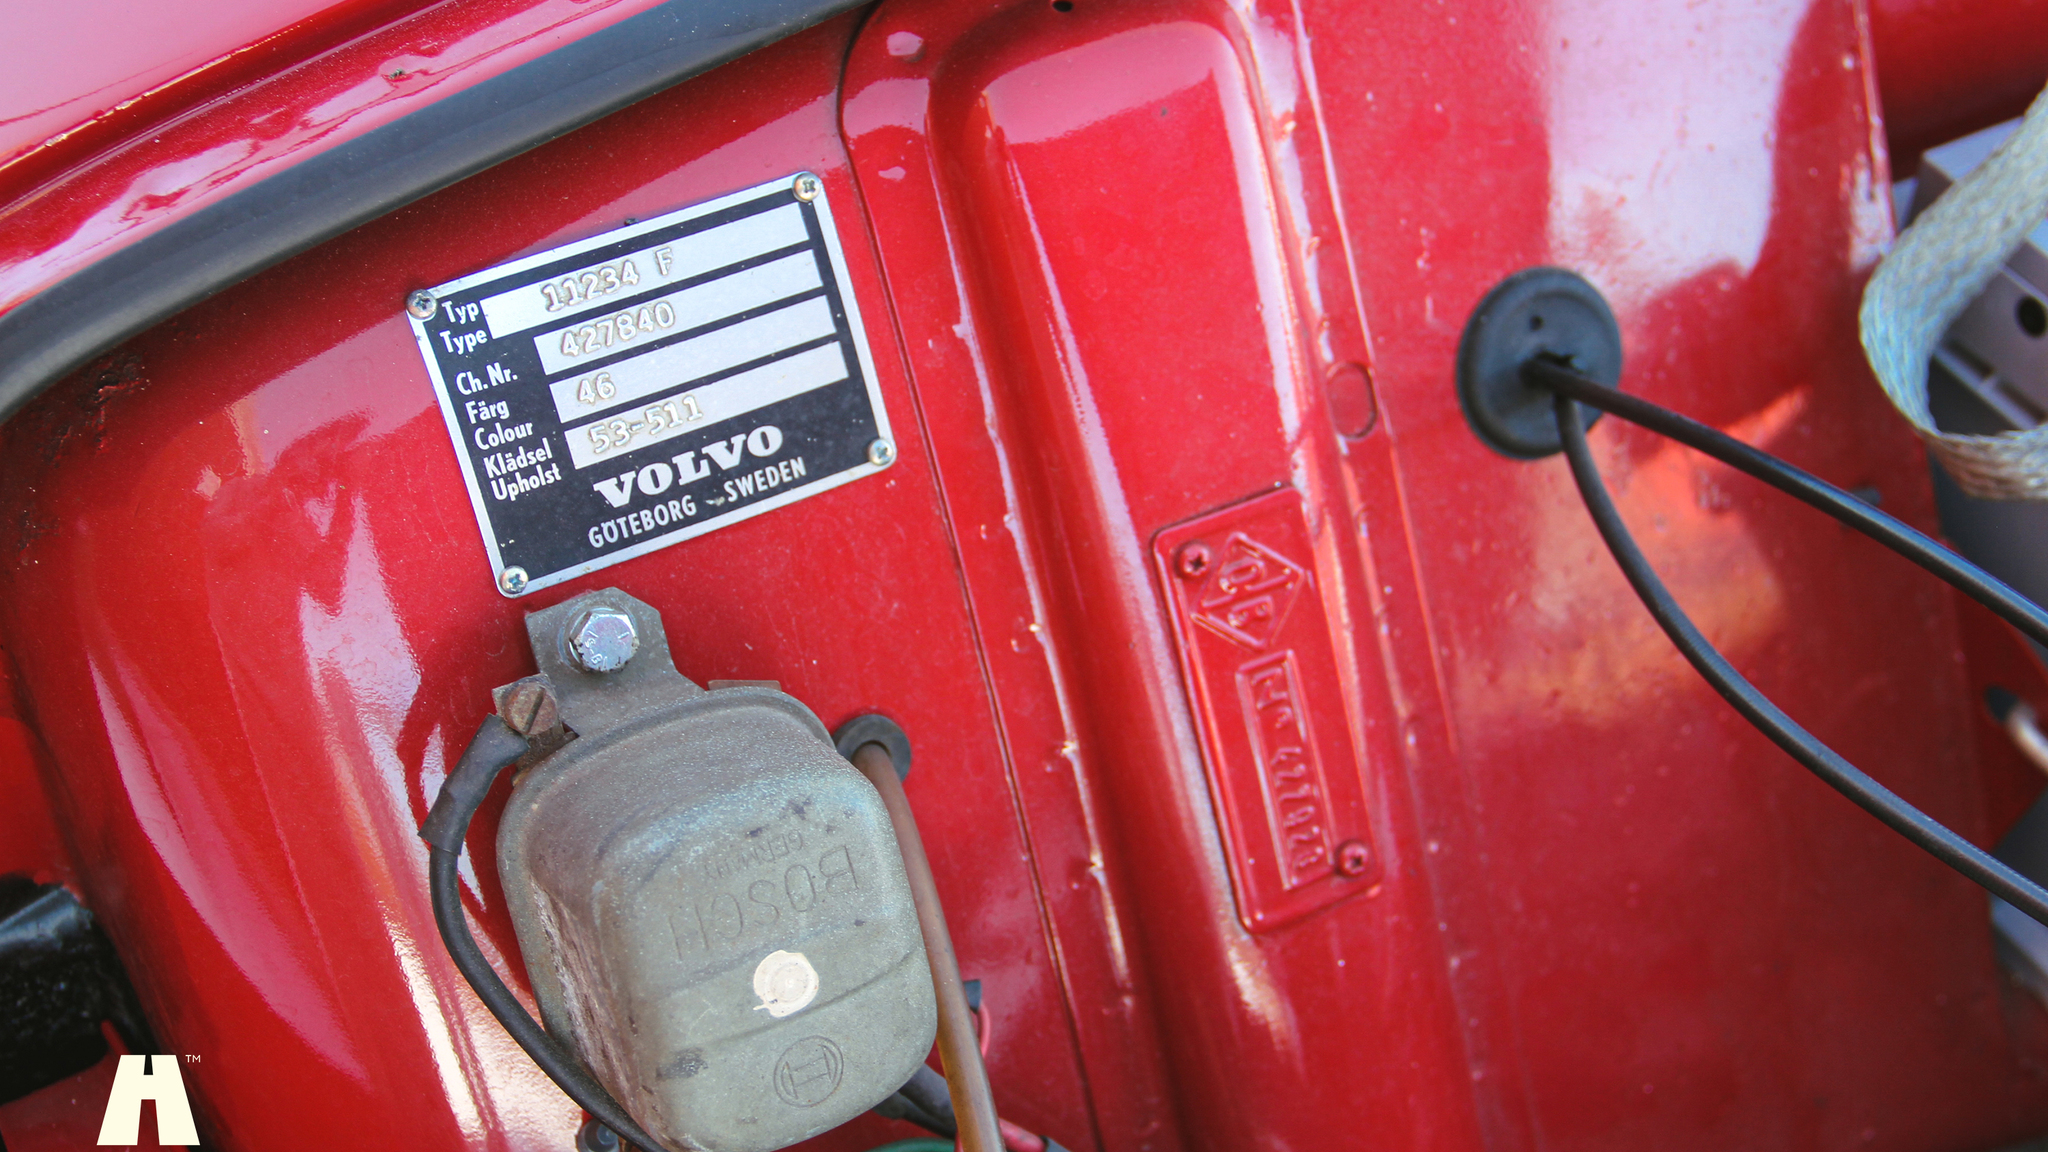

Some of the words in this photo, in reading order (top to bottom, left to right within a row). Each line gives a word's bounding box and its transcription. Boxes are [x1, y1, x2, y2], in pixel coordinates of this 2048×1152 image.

[541, 258, 640, 312] 11234
[654, 246, 673, 276] F
[441, 300, 480, 325] Typ
[561, 301, 676, 357] 427840
[439, 328, 488, 355] Type
[577, 371, 616, 405] 46
[464, 400, 510, 425] Färg
[588, 395, 704, 454] 53-511
[474, 422, 534, 450] Colour
[483, 437, 553, 478] Klädsel
[593, 424, 784, 509] VOLVO
[490, 462, 562, 502] Upholst
[588, 494, 698, 549] GÖTEBORG
[723, 456, 807, 503] SWEDEN
[668, 845, 860, 961] BOSCH
